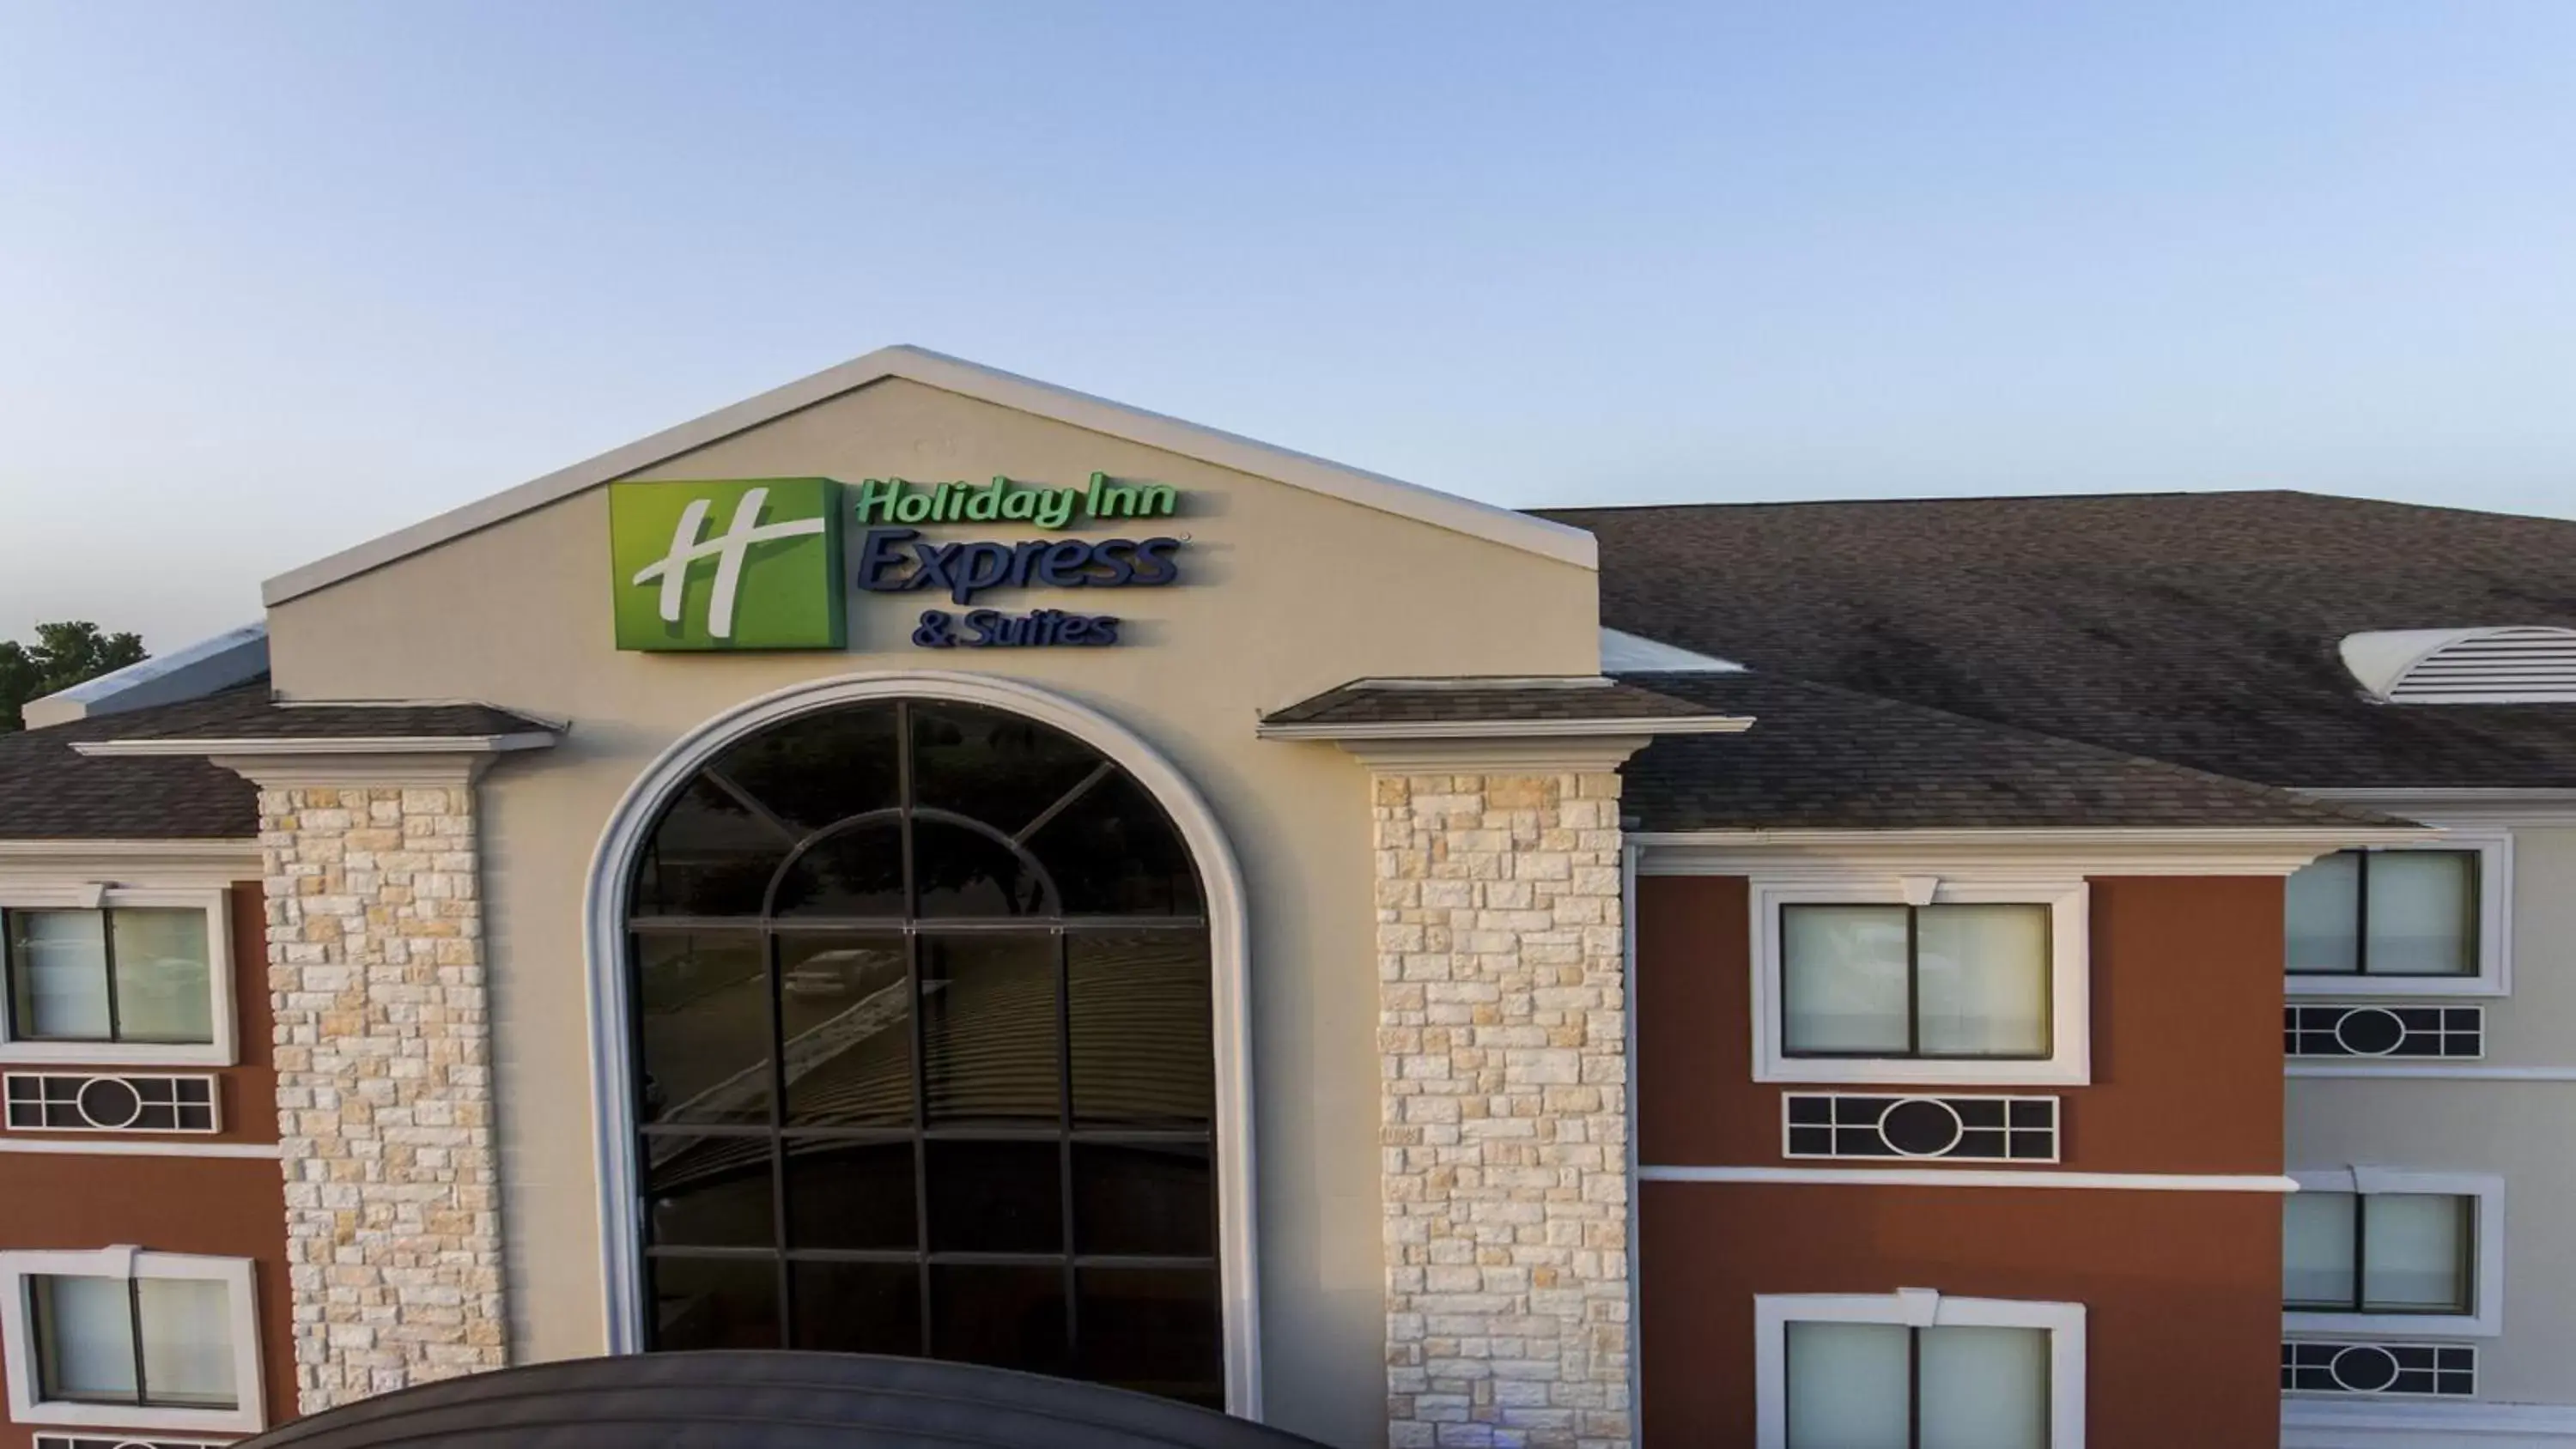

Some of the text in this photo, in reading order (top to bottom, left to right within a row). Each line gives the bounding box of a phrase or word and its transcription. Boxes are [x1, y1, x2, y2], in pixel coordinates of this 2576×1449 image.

[855, 471, 1176, 528] Holiday Inn
[633, 487, 825, 638] H
[858, 529, 1181, 605] Express
[912, 609, 1120, 647] & Suites
